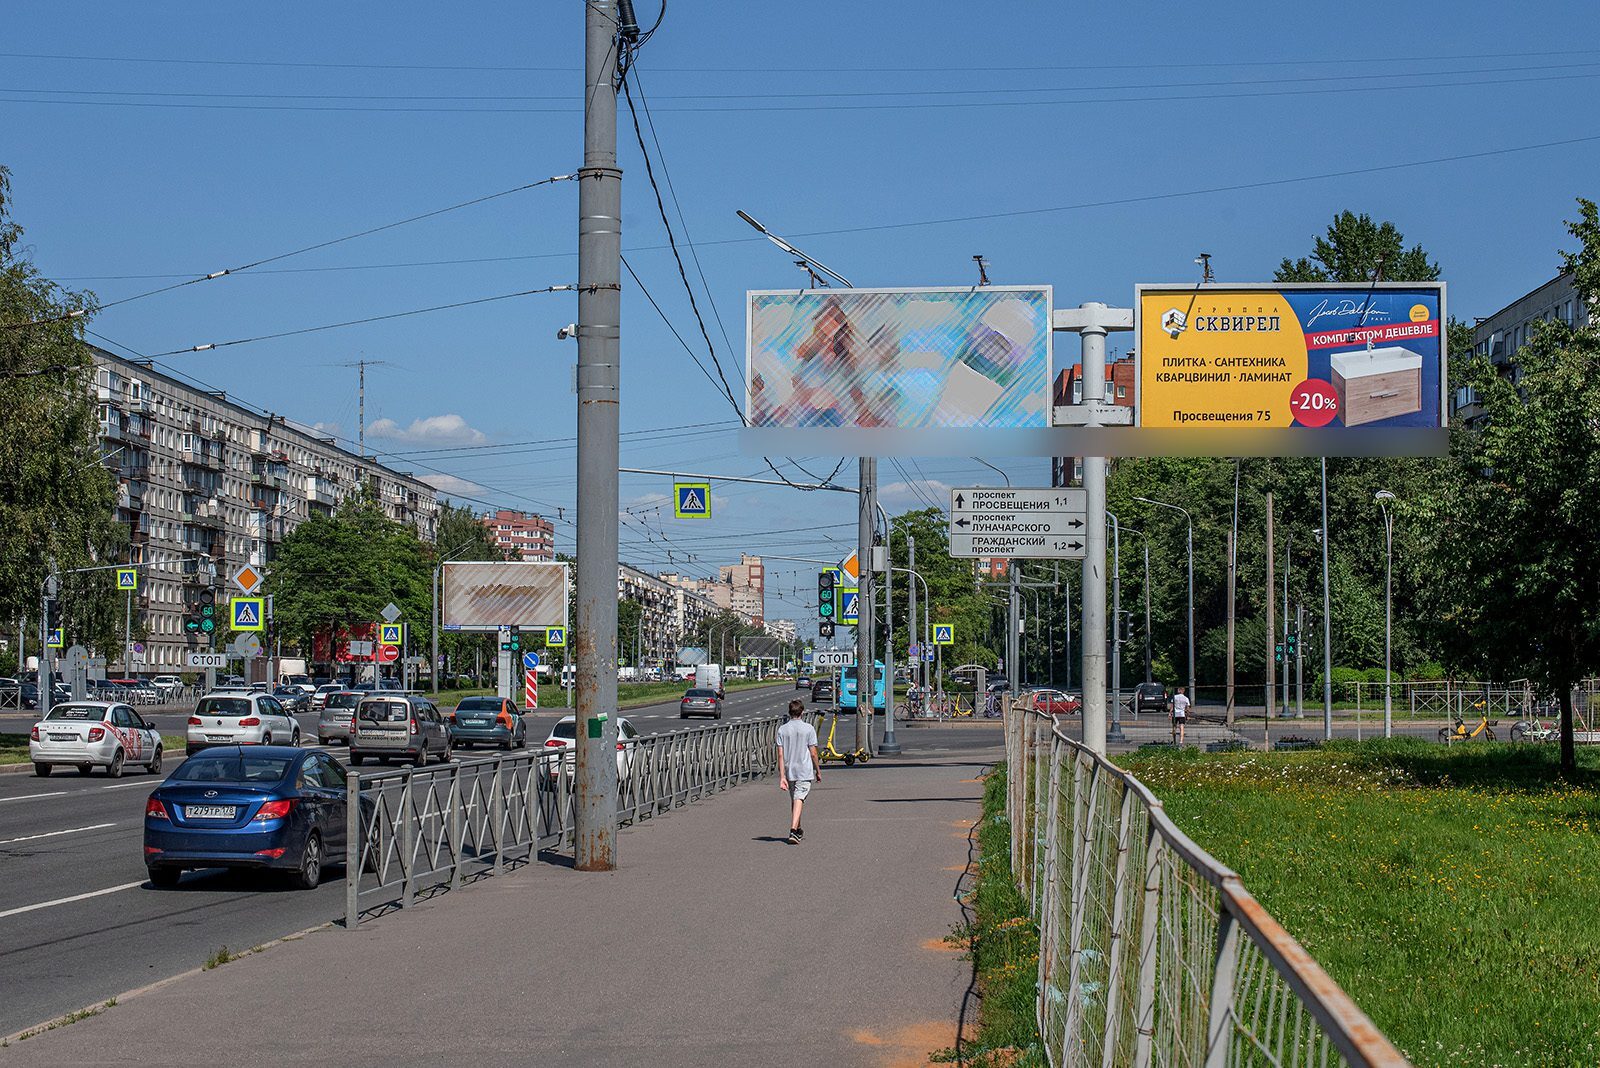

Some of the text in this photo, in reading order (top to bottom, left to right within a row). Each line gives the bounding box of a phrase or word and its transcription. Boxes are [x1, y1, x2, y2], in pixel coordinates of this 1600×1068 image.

[1195, 316, 1280, 331] СКВИРЕЛ
[1312, 324, 1433, 345] КОМПЛЕКТОМ ДЕШЕВЛЕ
[1162, 357, 1286, 367] ПЛИТКА САНТЕХНИКА
[1156, 372, 1292, 383] КВАРЦВИНИЛ ЛАМИНАТ
[1291, 393, 1337, 410] -20%
[1173, 411, 1271, 423] Просвещения 75
[972, 492, 1015, 500] проспект
[972, 501, 1050, 510] ПРОСВЕЩЕНИЯ
[1055, 497, 1067, 506] 1,1
[972, 514, 1015, 522] проспект
[972, 523, 1051, 532] ЛУНАЧАРСКОГО
[972, 536, 1046, 546] ГРАЖДАНСКИЙ
[972, 546, 1015, 554] проспект
[1053, 542, 1067, 551] 1,2
[821, 590, 832, 598] 60
[203, 607, 213, 615] 60
[192, 655, 221, 666] СТОП
[818, 653, 849, 664] СТОП
